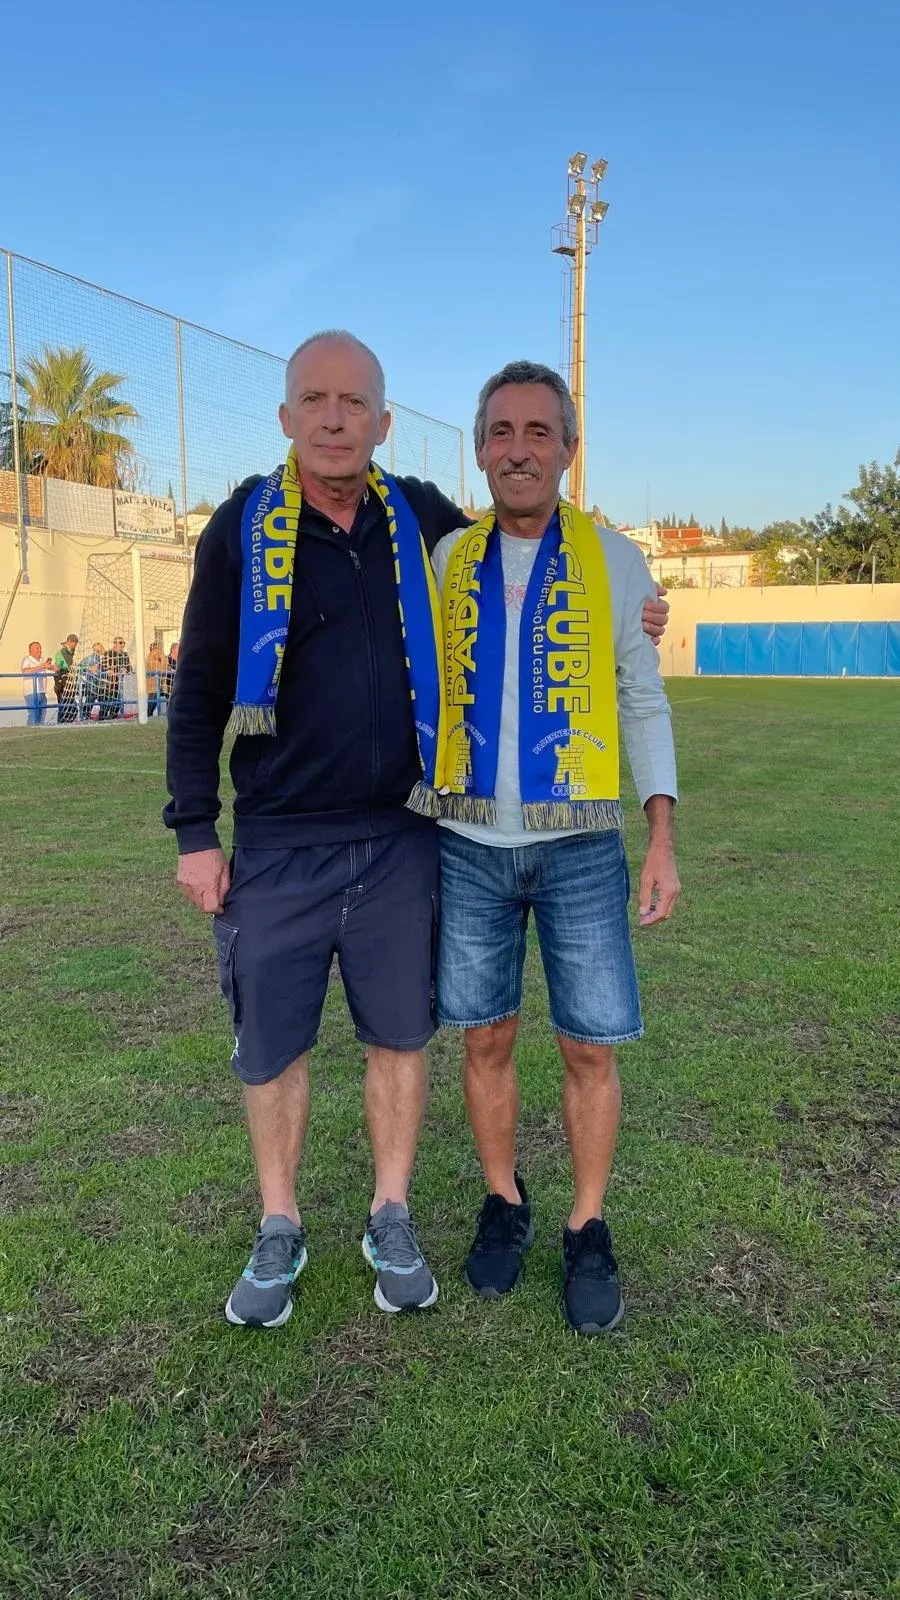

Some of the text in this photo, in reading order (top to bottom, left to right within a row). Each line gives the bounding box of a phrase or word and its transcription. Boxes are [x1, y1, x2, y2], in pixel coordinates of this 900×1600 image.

[448, 599, 456, 620] EM
[546, 542, 591, 713] CLUBE
[532, 728, 608, 755] PADERNENSE CLUBE
